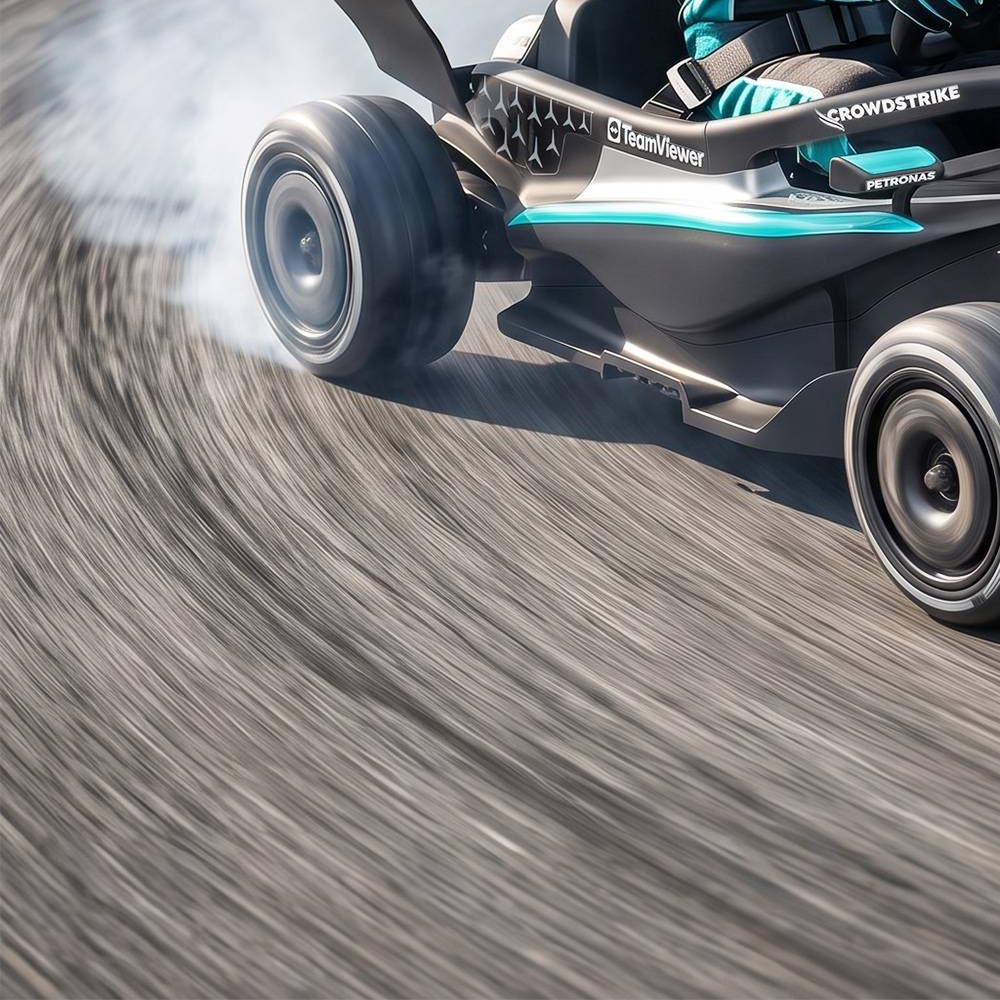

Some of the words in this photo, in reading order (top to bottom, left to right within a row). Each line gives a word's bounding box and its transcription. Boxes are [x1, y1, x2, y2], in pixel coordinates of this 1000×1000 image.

[826, 85, 961, 122] CROWDSTRIKE
[621, 123, 705, 168] TeamViewer
[866, 171, 937, 190] PETRONAS
